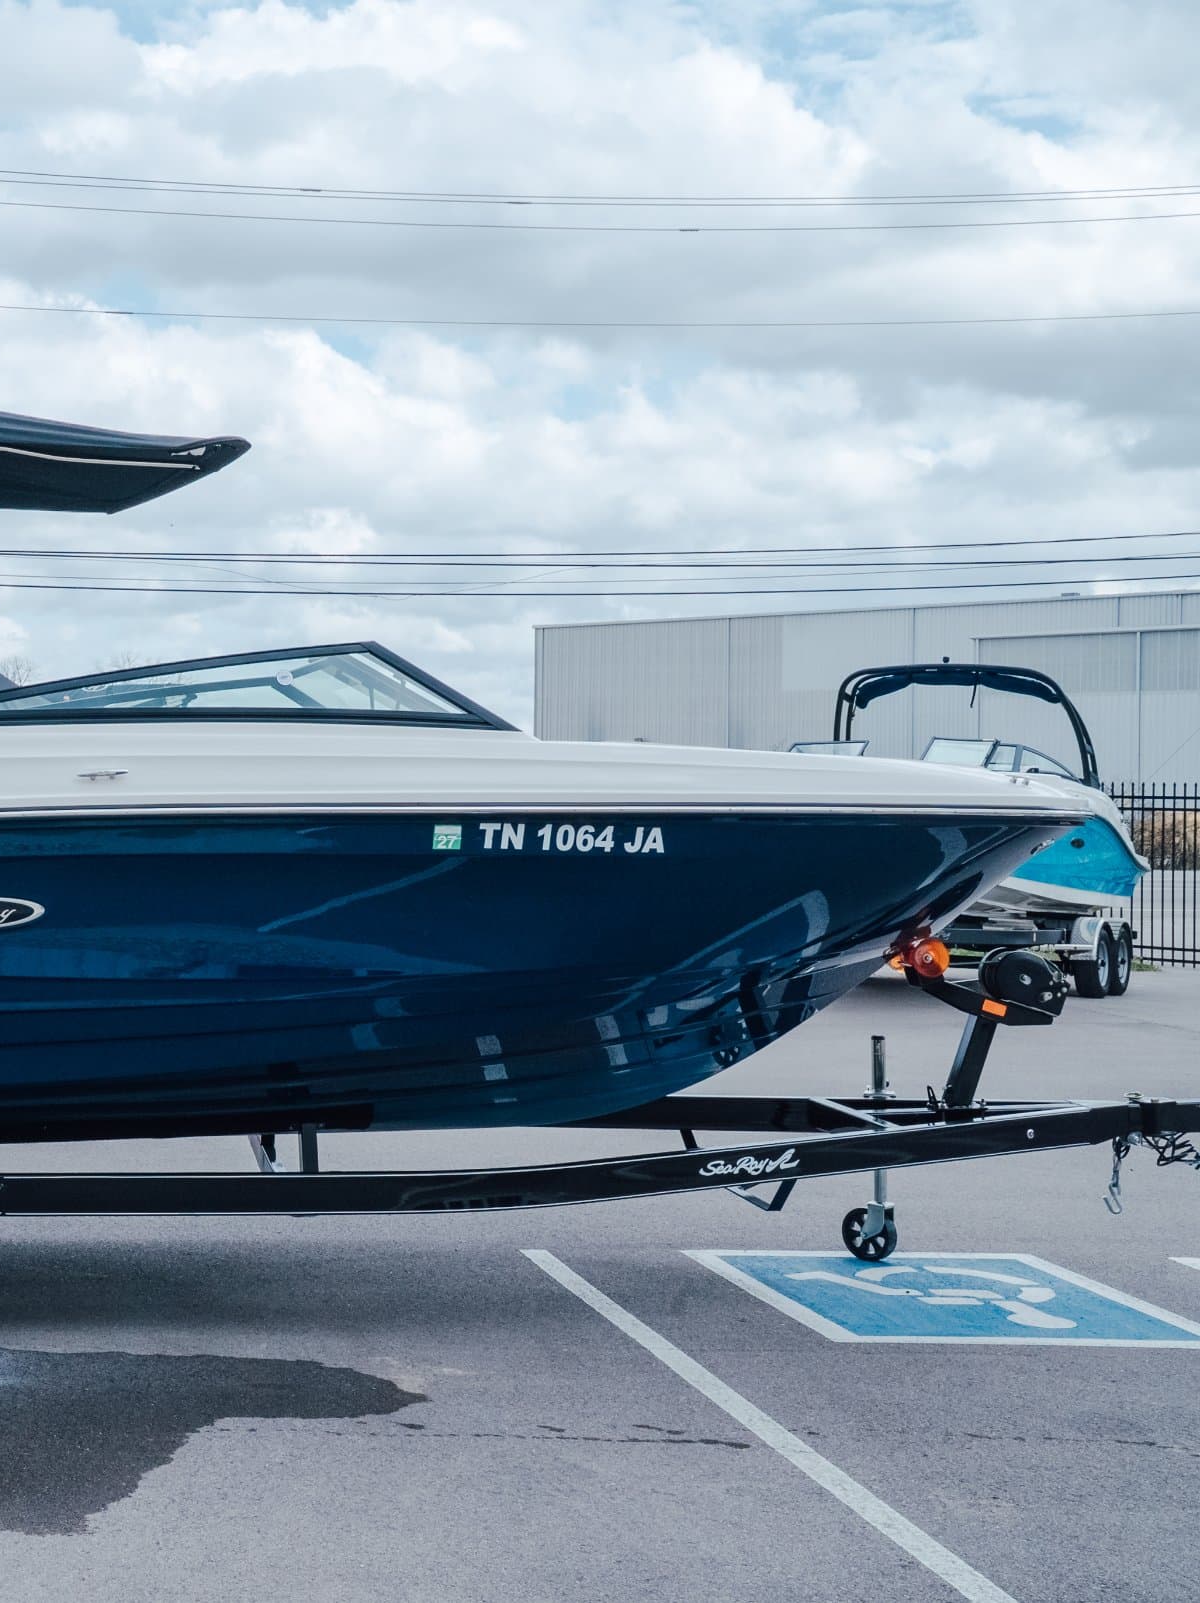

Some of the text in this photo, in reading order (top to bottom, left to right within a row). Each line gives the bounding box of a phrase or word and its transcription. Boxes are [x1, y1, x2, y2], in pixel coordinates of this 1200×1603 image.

[437, 835, 457, 849] 27
[479, 823, 665, 853] TN 1064 JA
